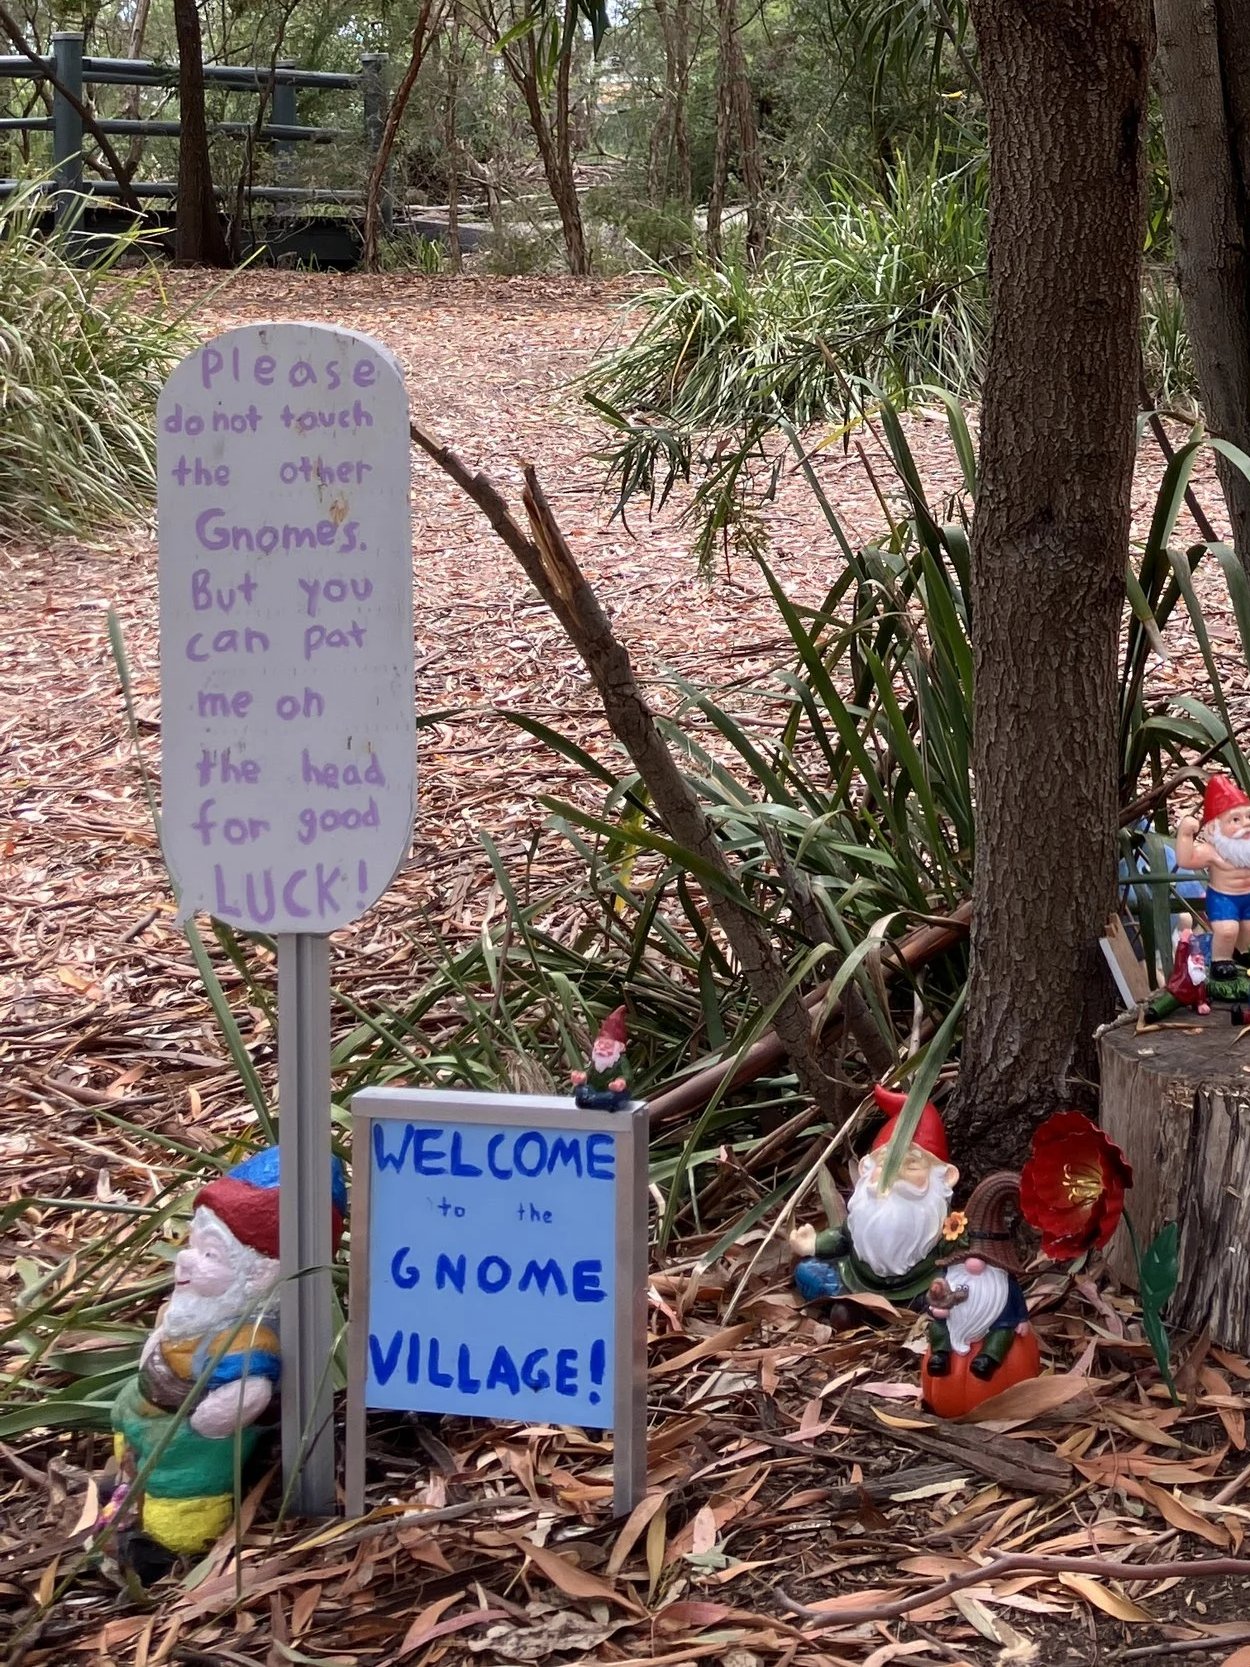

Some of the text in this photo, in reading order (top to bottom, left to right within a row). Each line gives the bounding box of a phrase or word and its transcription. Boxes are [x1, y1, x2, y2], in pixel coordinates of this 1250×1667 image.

[202, 347, 376, 389] Please
[164, 399, 374, 435] do not touch
[171, 455, 373, 486] the other
[196, 508, 367, 554] Gnomes.
[192, 569, 373, 617] But you
[186, 621, 367, 661] can pat
[198, 687, 325, 720] me on
[196, 748, 385, 789] the head
[192, 795, 381, 846] for good
[214, 859, 368, 924] LUCK!
[373, 1123, 616, 1180] WELCOME
[437, 1196, 553, 1224] to the
[391, 1246, 608, 1303] GNOME
[369, 1330, 605, 1405] VILLAGE!
